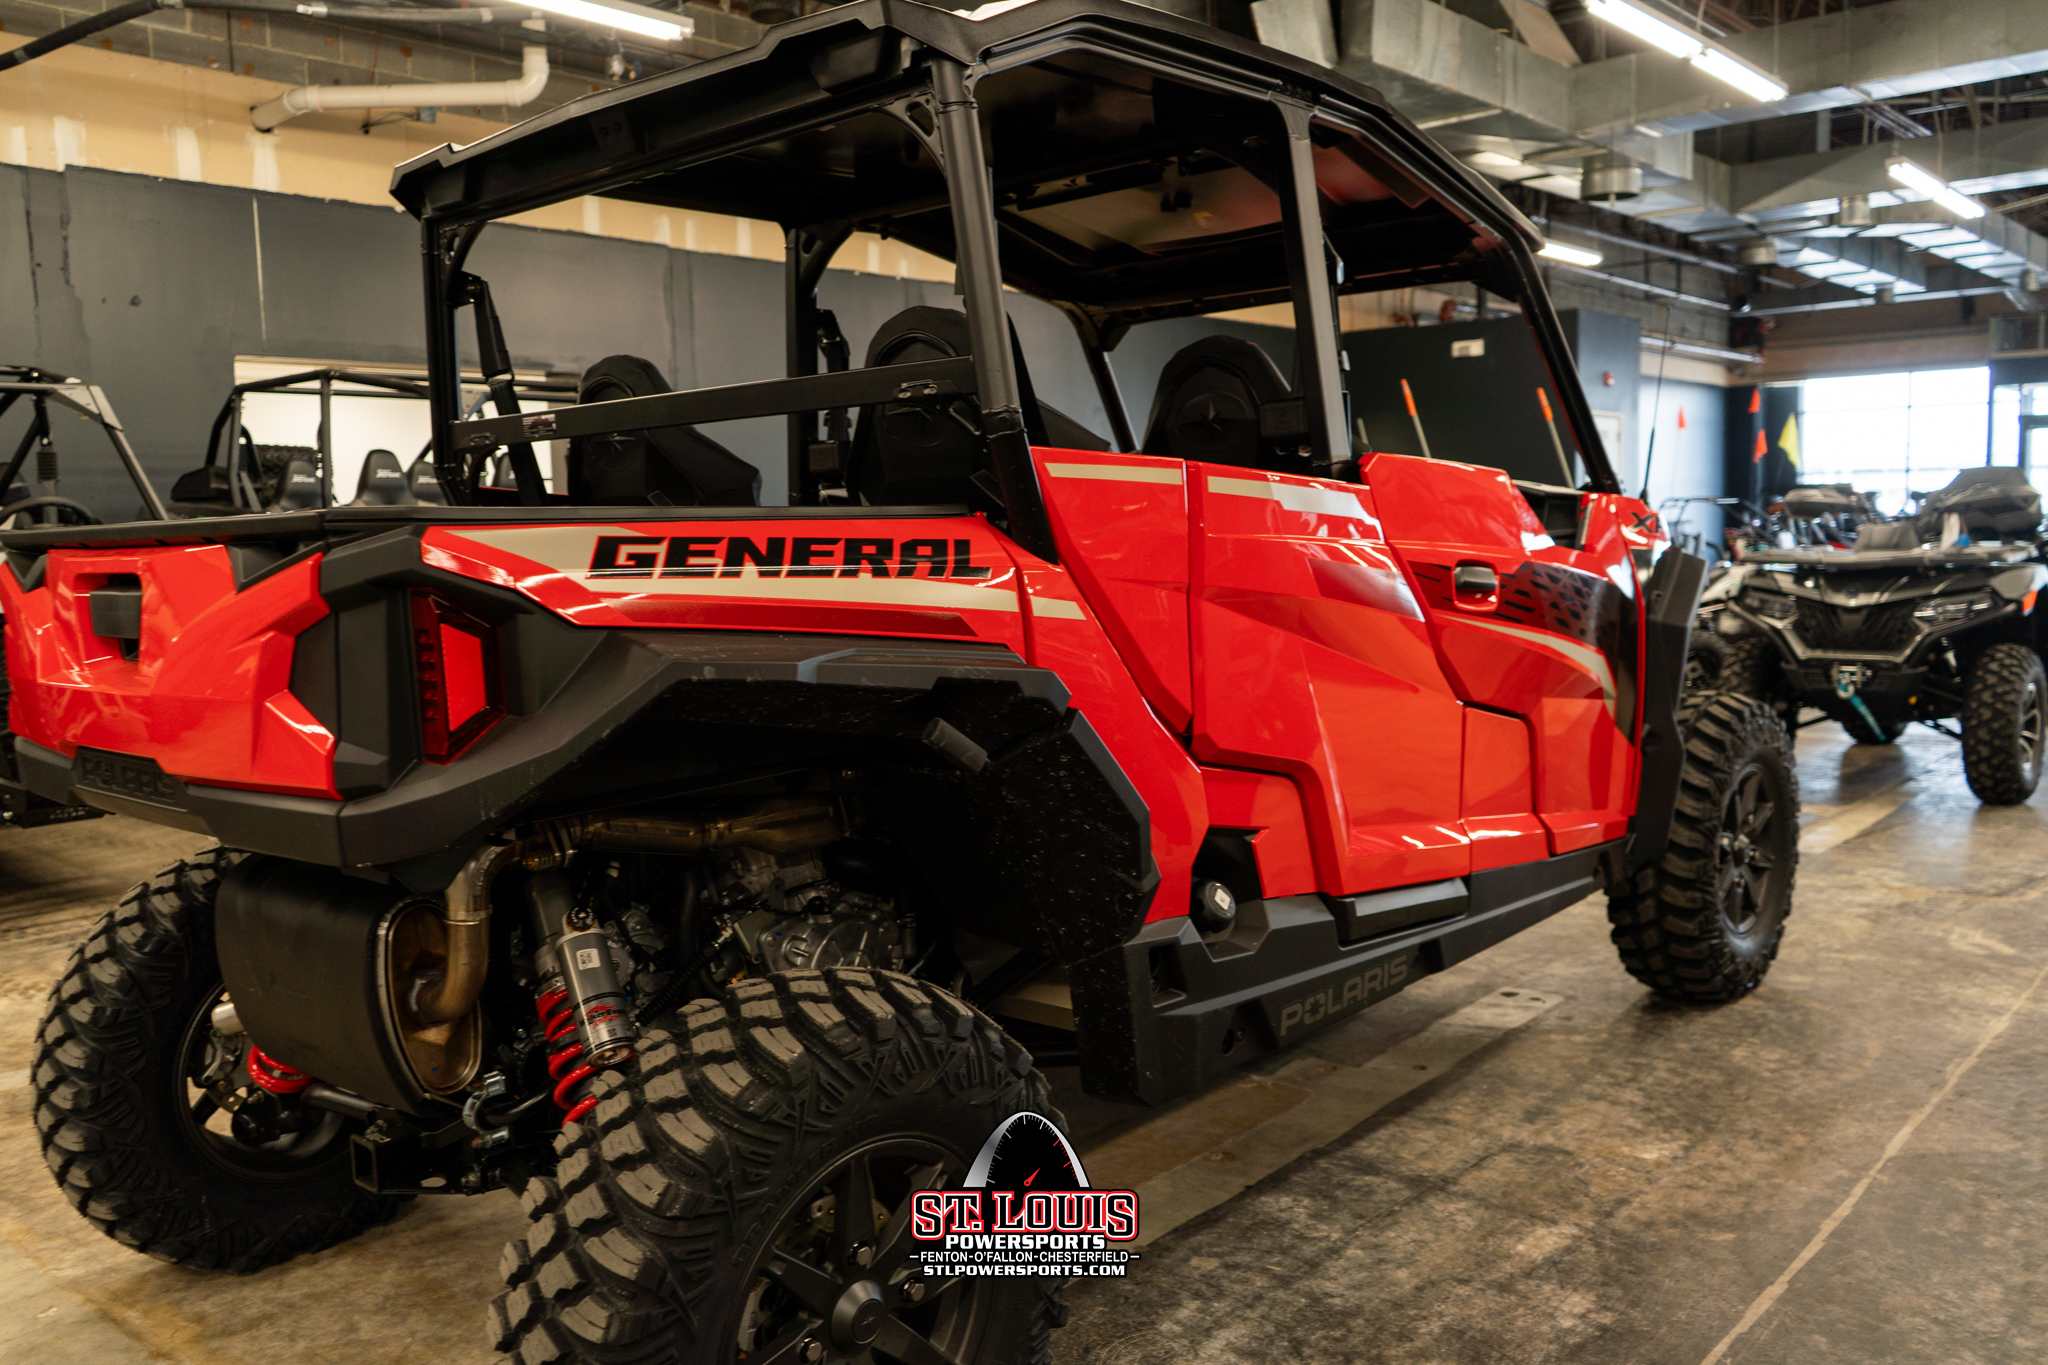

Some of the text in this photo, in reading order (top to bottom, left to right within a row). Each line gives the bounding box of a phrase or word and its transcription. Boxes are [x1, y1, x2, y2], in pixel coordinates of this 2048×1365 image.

[585, 535, 993, 579] GENERAL
[80, 756, 176, 802] POLARIS
[1279, 954, 1408, 1037] POLARIS
